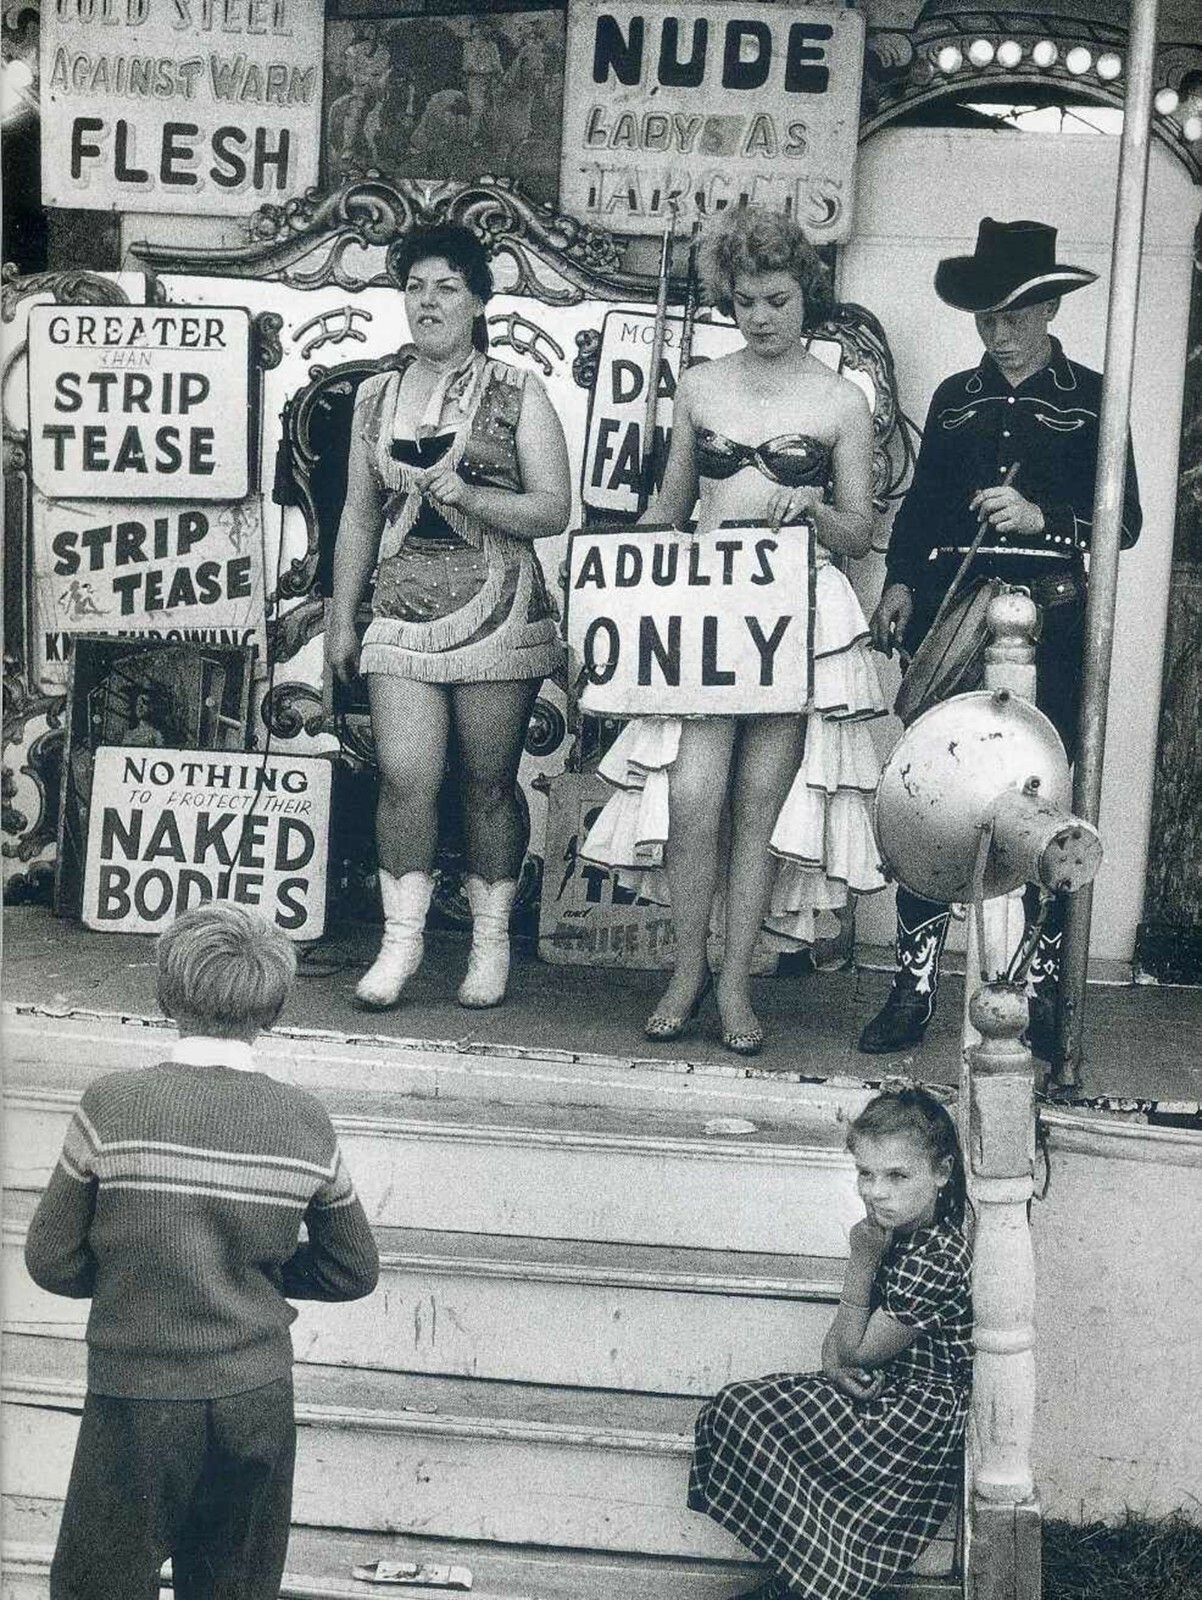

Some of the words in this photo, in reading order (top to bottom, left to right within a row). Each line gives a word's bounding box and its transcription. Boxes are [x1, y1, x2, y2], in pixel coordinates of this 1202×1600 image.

[173, 0, 293, 37] STEEL
[50, 48, 203, 100] AGAINST
[208, 52, 319, 107] WARM
[593, 14, 834, 94] NUDE
[71, 117, 291, 191] FLESH
[583, 104, 702, 153] LADY
[741, 112, 808, 159] AS
[49, 316, 226, 347] GREATER
[101, 350, 152, 366] THAN
[621, 323, 684, 349] MOR
[54, 372, 210, 414] STRIP
[42, 424, 216, 475] TEASE
[52, 511, 209, 576] STRIP
[574, 539, 779, 589] ADULTS
[113, 556, 251, 616] TEASE
[584, 615, 792, 686] ONLY
[122, 757, 308, 793] NOTHING
[129, 790, 152, 804] TO
[167, 791, 250, 810] PROTECT
[263, 795, 312, 816] THEIR
[100, 807, 315, 872] NAKED
[97, 864, 309, 930] BODIES
